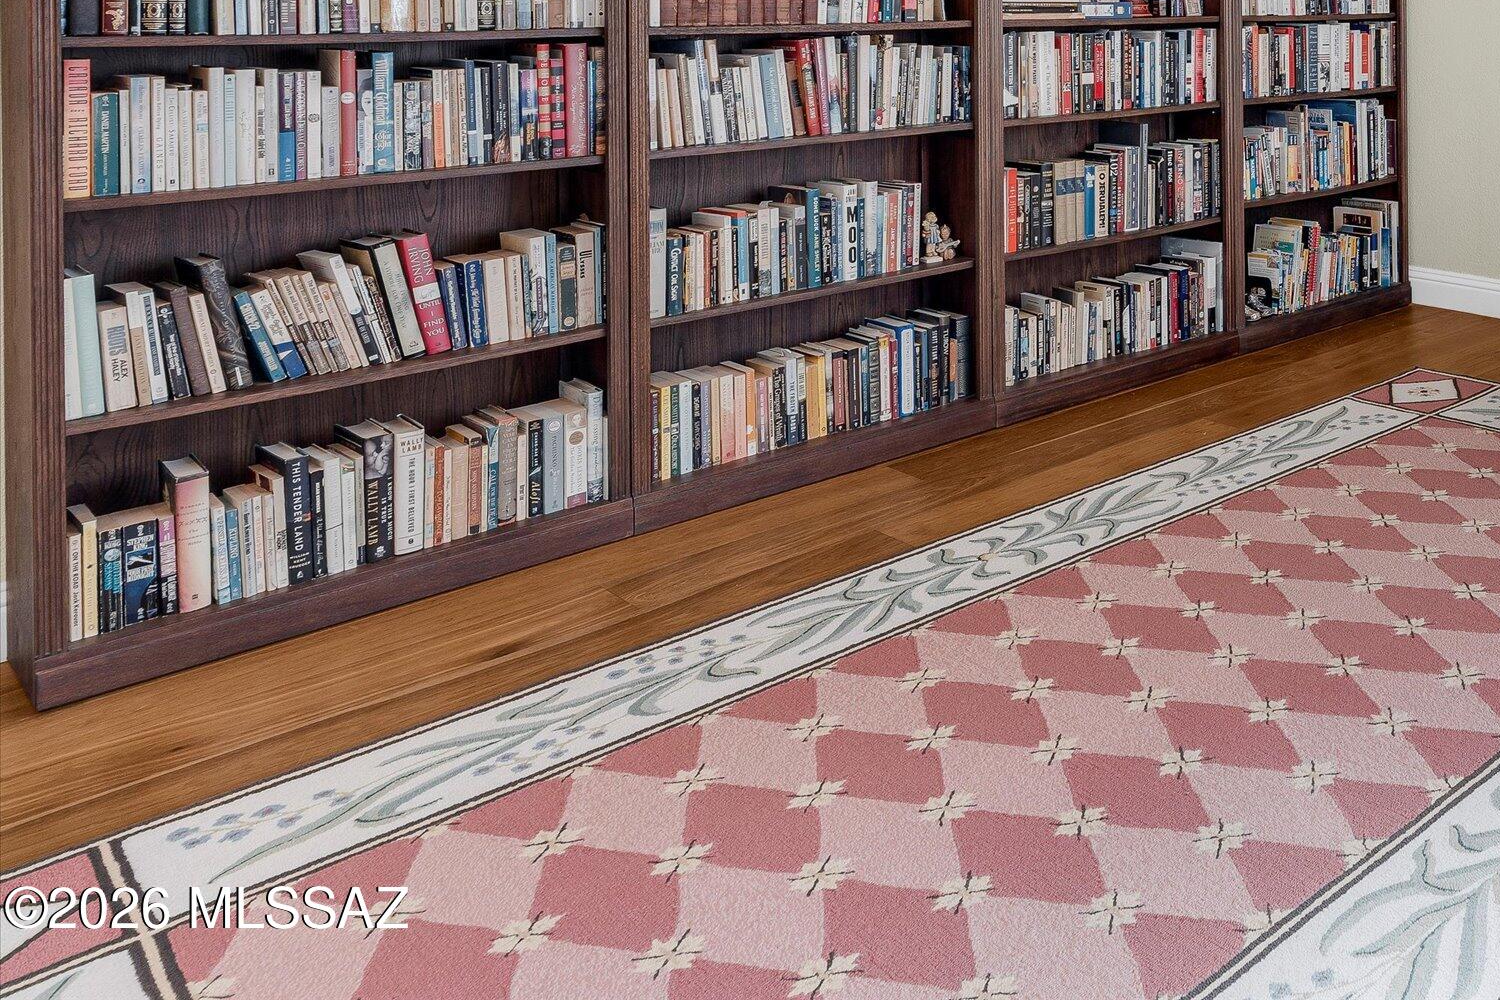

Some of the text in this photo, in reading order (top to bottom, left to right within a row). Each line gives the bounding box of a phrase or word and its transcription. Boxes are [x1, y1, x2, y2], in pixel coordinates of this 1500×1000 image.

[375, 59, 389, 126] William Goldman
[68, 66, 88, 191] CANADA RICHARD FORD
[101, 111, 109, 154] DANIEL MARTIN
[1110, 158, 1118, 177] 102
[408, 247, 423, 284] IRVING
[419, 248, 432, 277] JOHN
[579, 250, 593, 279] ULYSSES
[671, 248, 681, 272] CONTACT
[240, 303, 260, 331] CATCH-22
[107, 325, 128, 356] ROOTS
[112, 358, 121, 382] HALEY
[120, 360, 128, 378] ALEX
[774, 389, 782, 412] Grapes
[775, 421, 784, 441] Wrath
[408, 458, 416, 469] THE
[408, 471, 416, 485] HOUR
[408, 489, 416, 505] FIRST
[530, 481, 540, 505] Aloft
[291, 462, 303, 551] THIS TENDER LAND
[366, 481, 379, 546] WALLY LAMB
[408, 506, 416, 532] BELIEVED
[71, 552, 79, 560] ON
